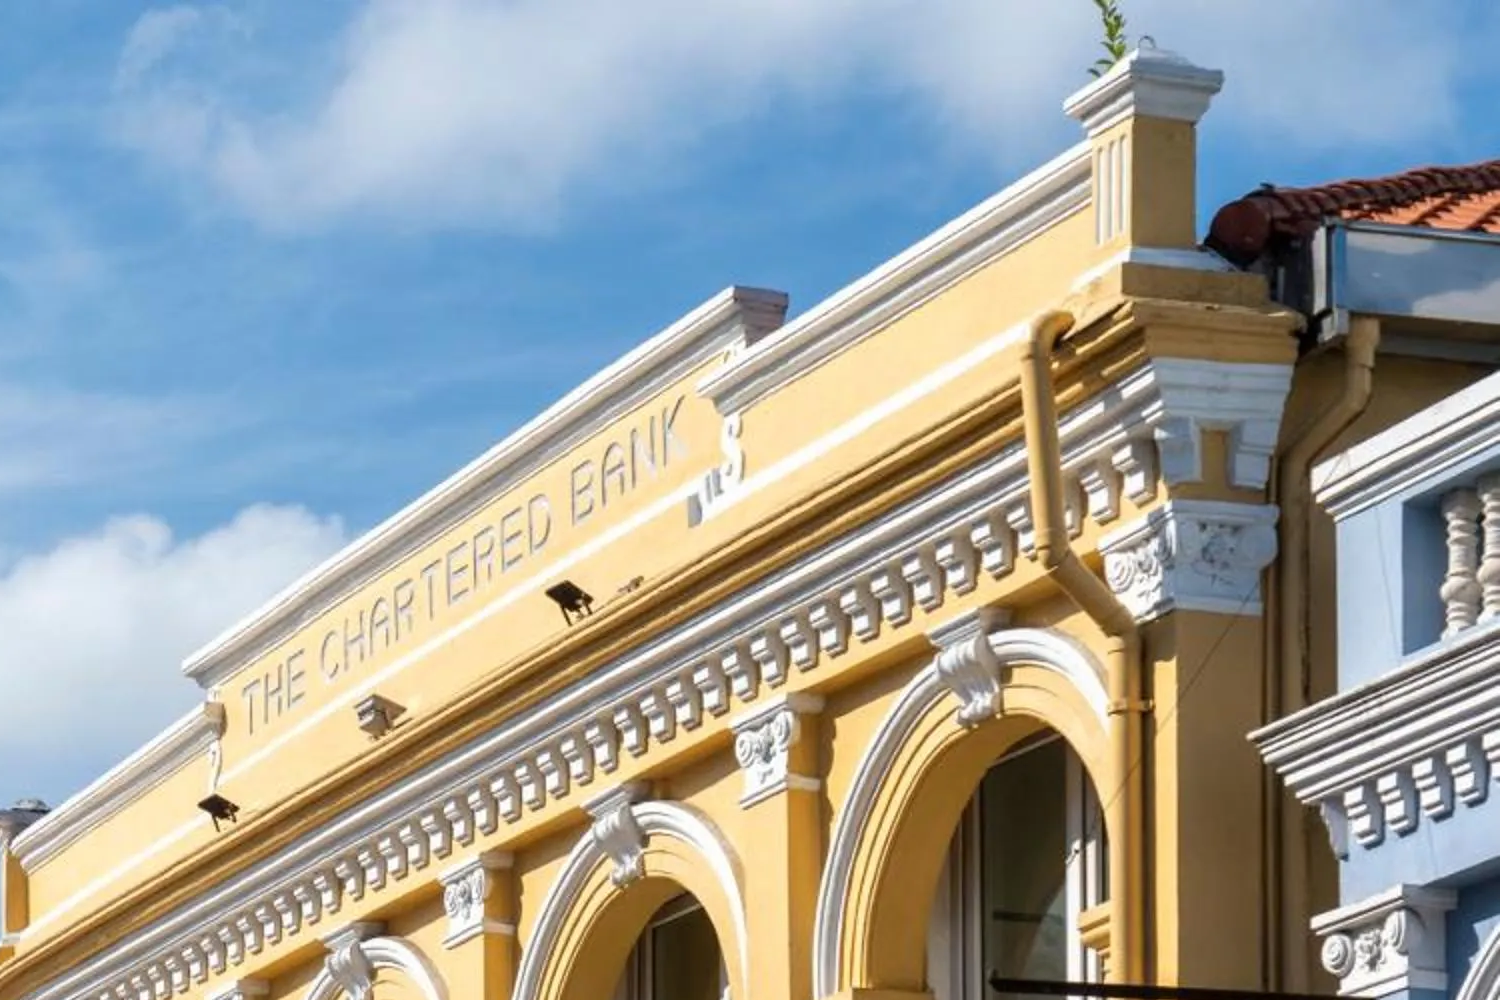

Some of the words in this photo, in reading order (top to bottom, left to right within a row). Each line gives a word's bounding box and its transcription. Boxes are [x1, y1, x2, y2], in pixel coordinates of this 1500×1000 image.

[242, 648, 305, 735] THE
[319, 493, 551, 685] CHARTERED
[570, 395, 688, 528] BANK
